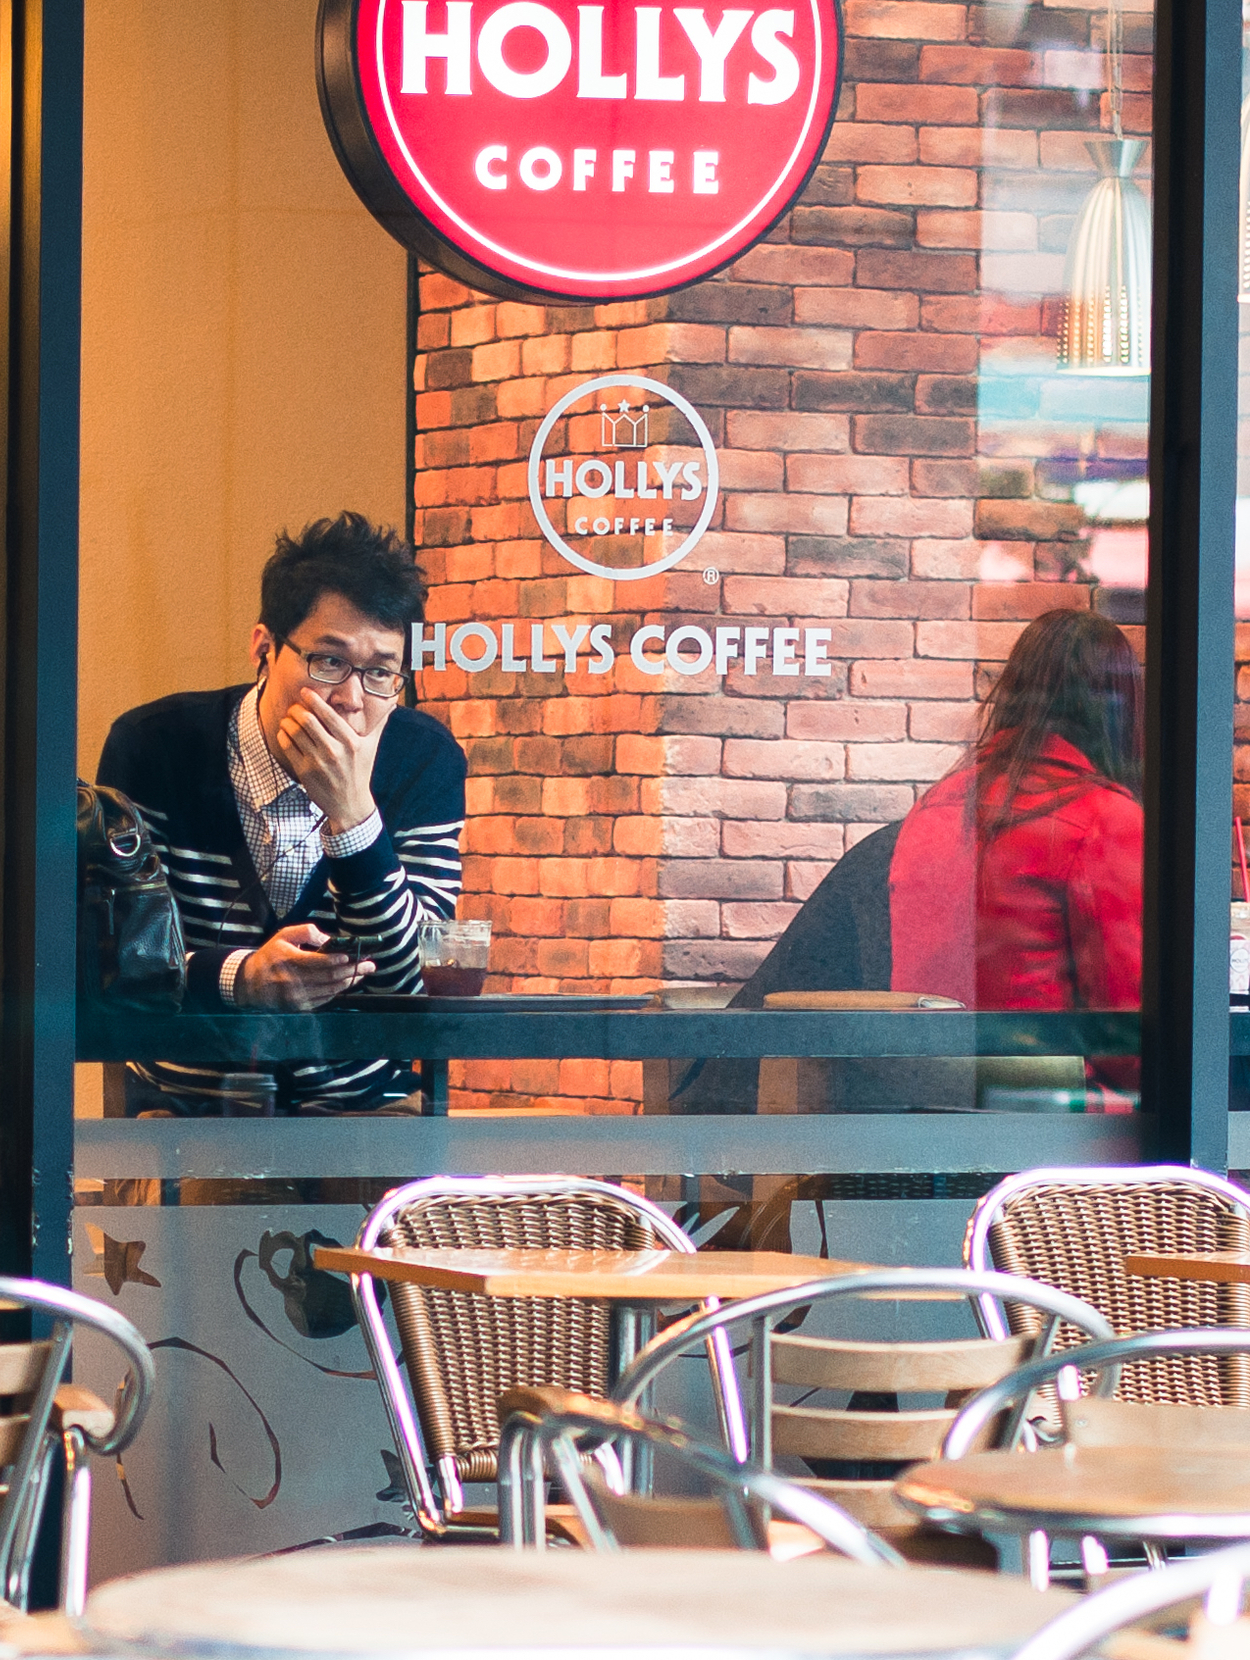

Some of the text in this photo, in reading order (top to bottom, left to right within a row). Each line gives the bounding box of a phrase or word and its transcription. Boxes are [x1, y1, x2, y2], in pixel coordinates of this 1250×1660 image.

[400, 1, 800, 105] HOLLYS
[474, 144, 720, 194] COFFEE
[545, 459, 703, 501] HOLLYS
[574, 516, 674, 536] COFFEE
[411, 621, 832, 677] HOLLYS COFFEE
